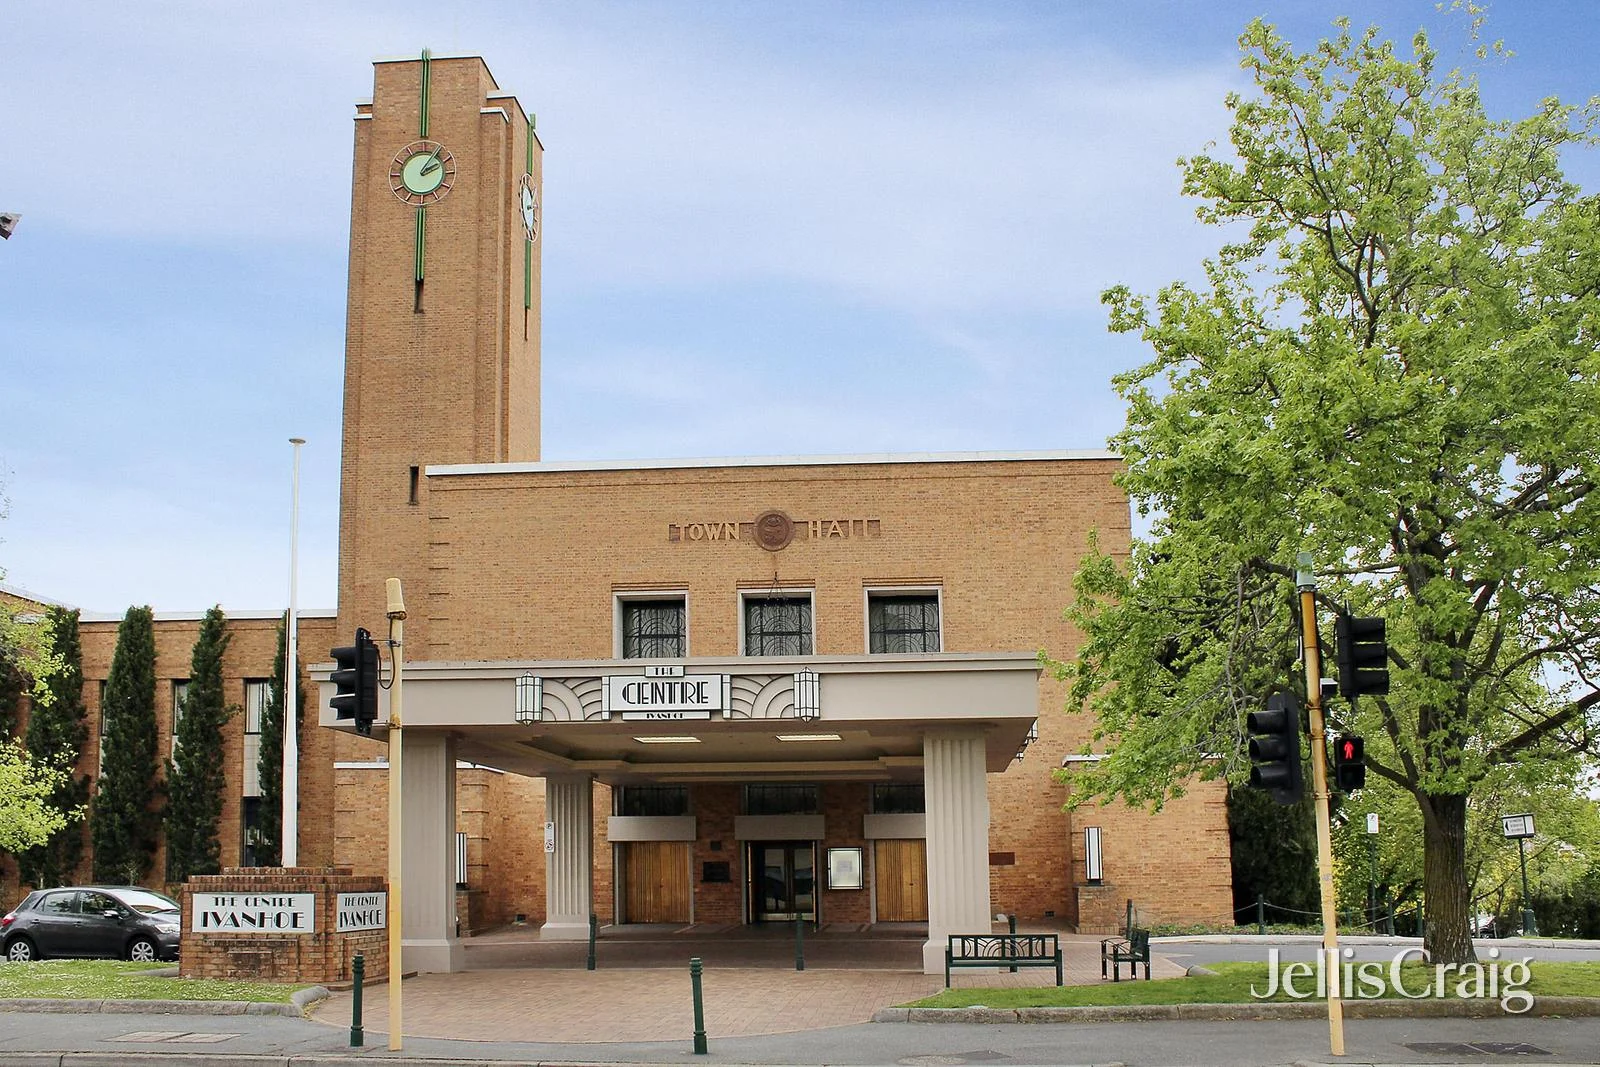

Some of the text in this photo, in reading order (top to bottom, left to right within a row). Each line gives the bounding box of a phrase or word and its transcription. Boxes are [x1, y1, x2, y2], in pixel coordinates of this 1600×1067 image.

[675, 522, 740, 541] TOWN
[654, 667, 674, 676] THE
[622, 681, 709, 704] CENTRE
[212, 897, 296, 907] THE CENTRE
[343, 896, 356, 906] THE
[201, 911, 305, 929] IVANHOE
[339, 909, 383, 928] IVANHOE
